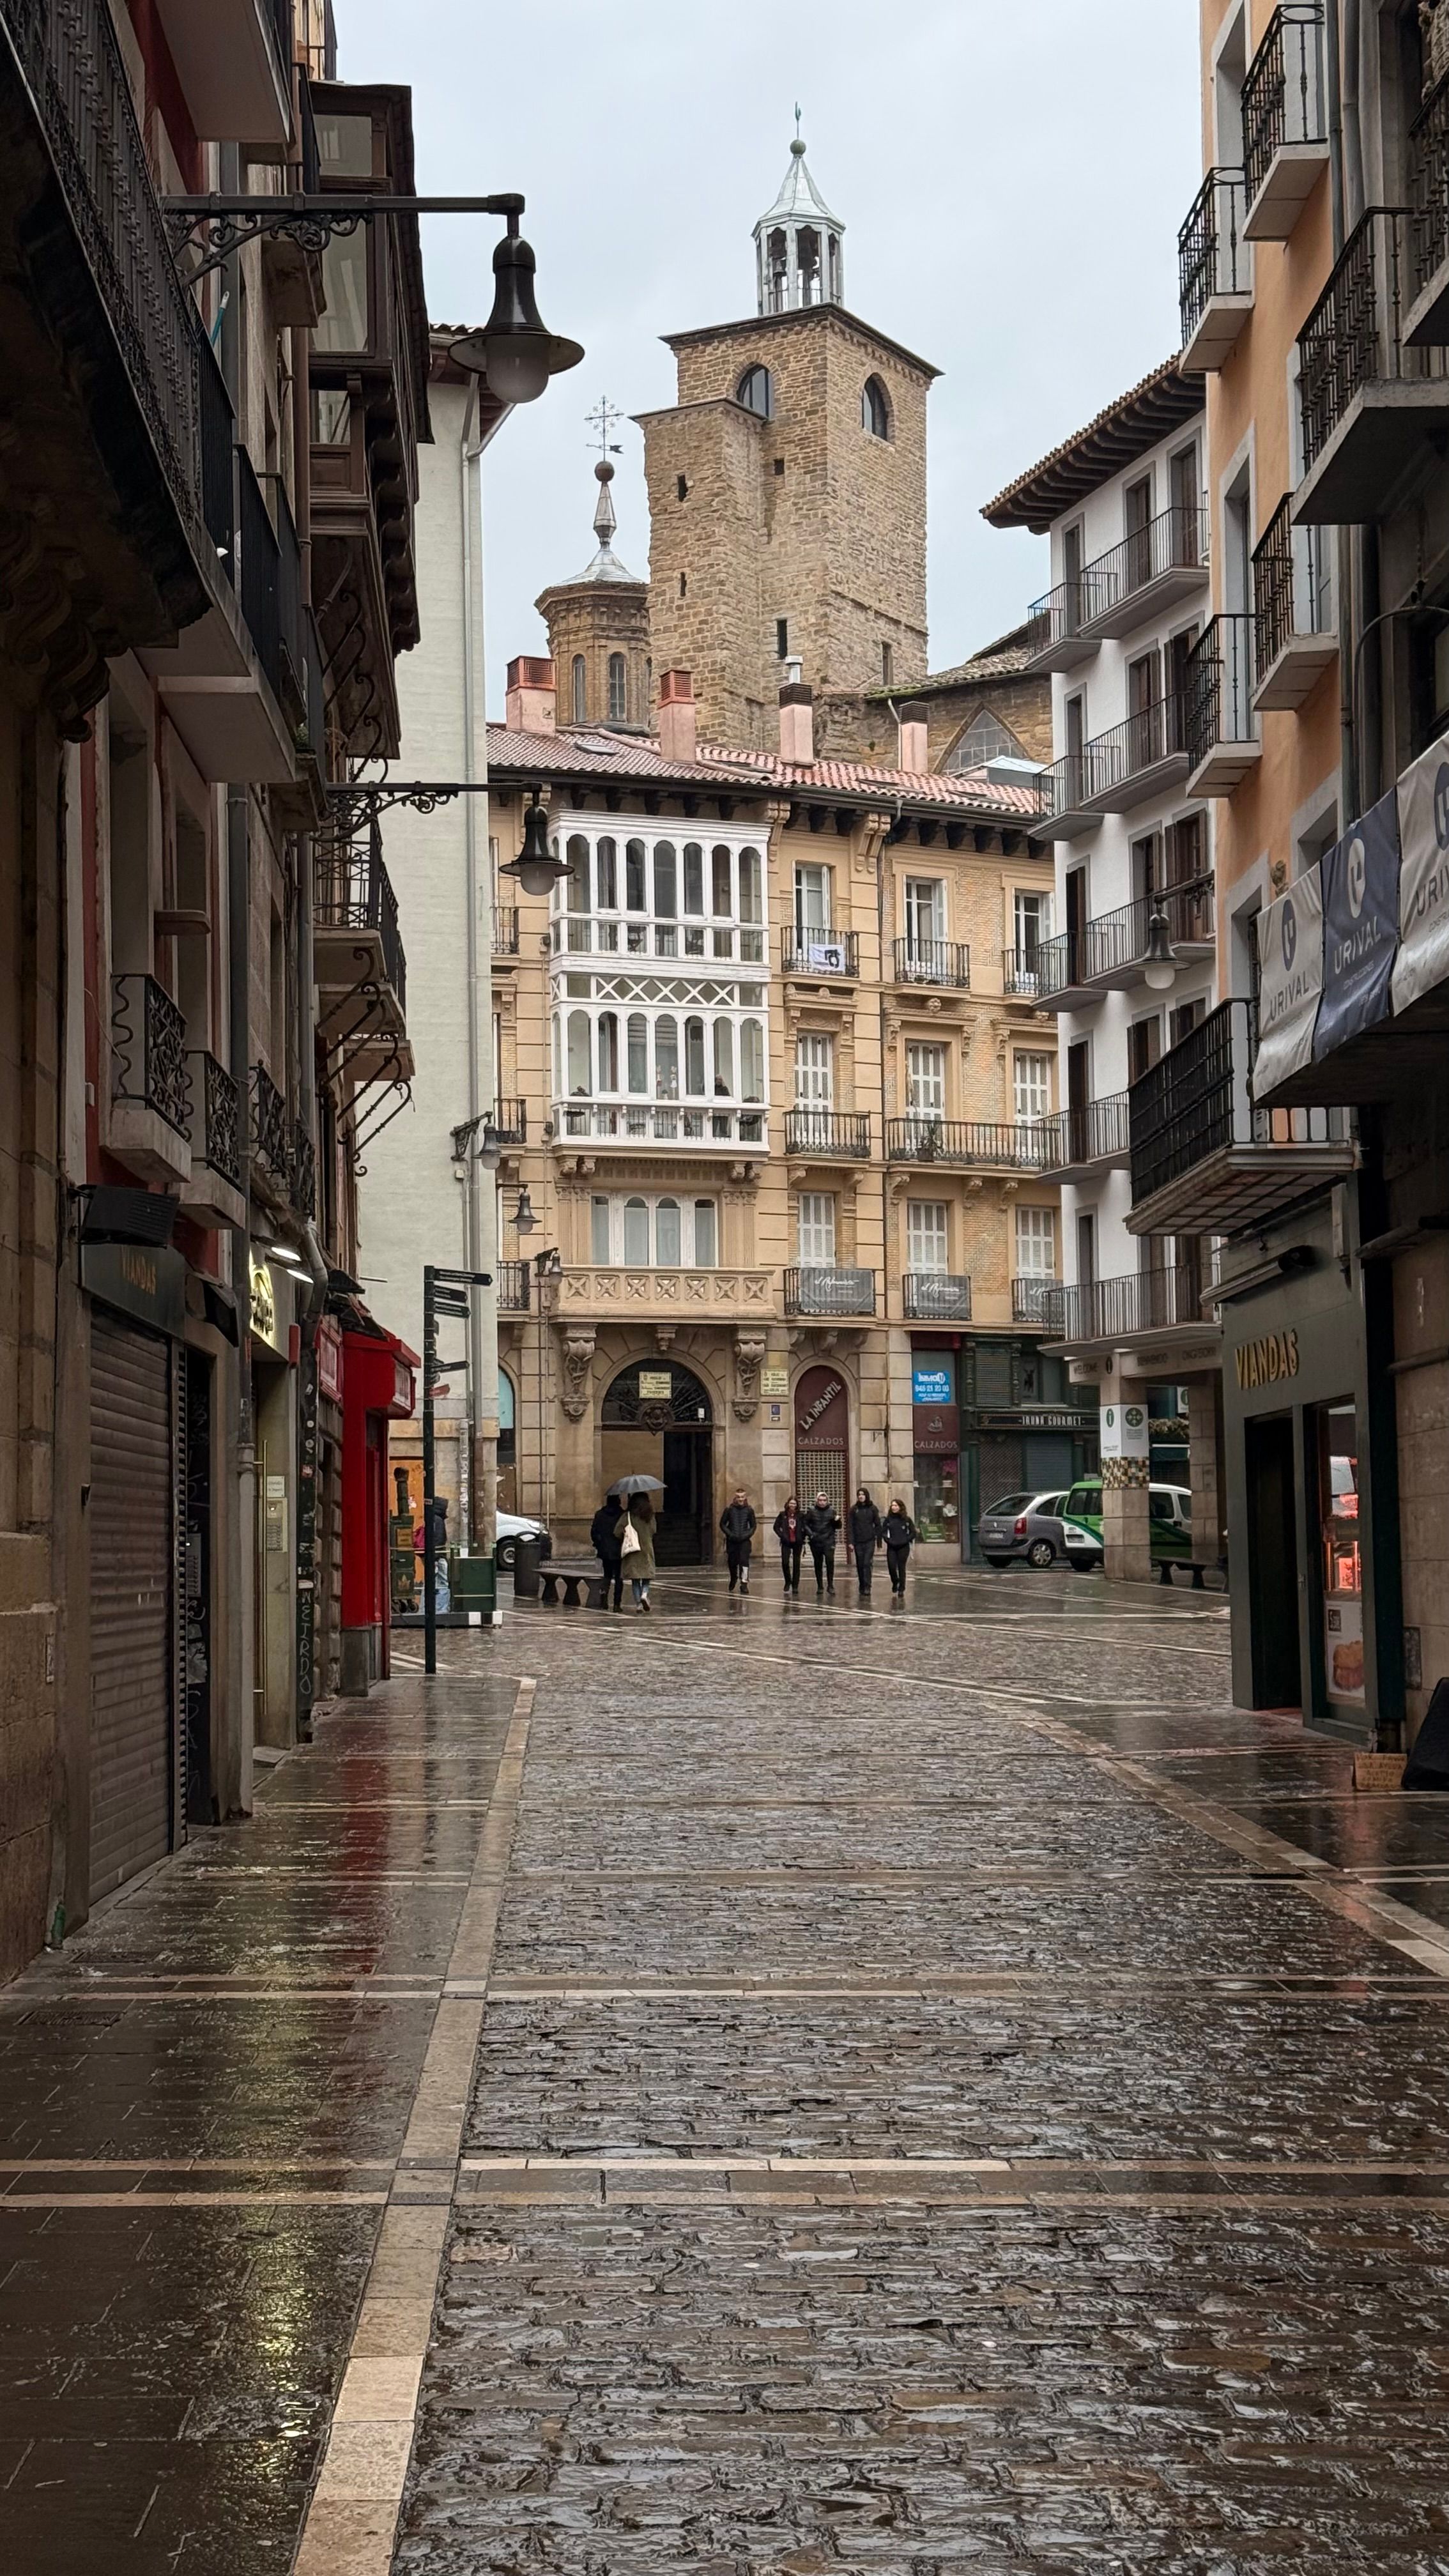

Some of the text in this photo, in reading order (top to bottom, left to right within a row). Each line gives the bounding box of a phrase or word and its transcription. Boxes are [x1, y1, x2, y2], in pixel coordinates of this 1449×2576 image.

[1334, 915, 1381, 975] URIVAL
[1269, 970, 1310, 1022] URIVAL
[121, 1246, 157, 1296] VIANDAS
[1234, 1328, 1300, 1391] VIANDAS
[799, 1381, 842, 1430] LA INFANTIL
[1048, 1415, 1082, 1426] GOURMET
[797, 1436, 844, 1445] CALZADOS
[914, 1441, 958, 1449] CALZADOS
